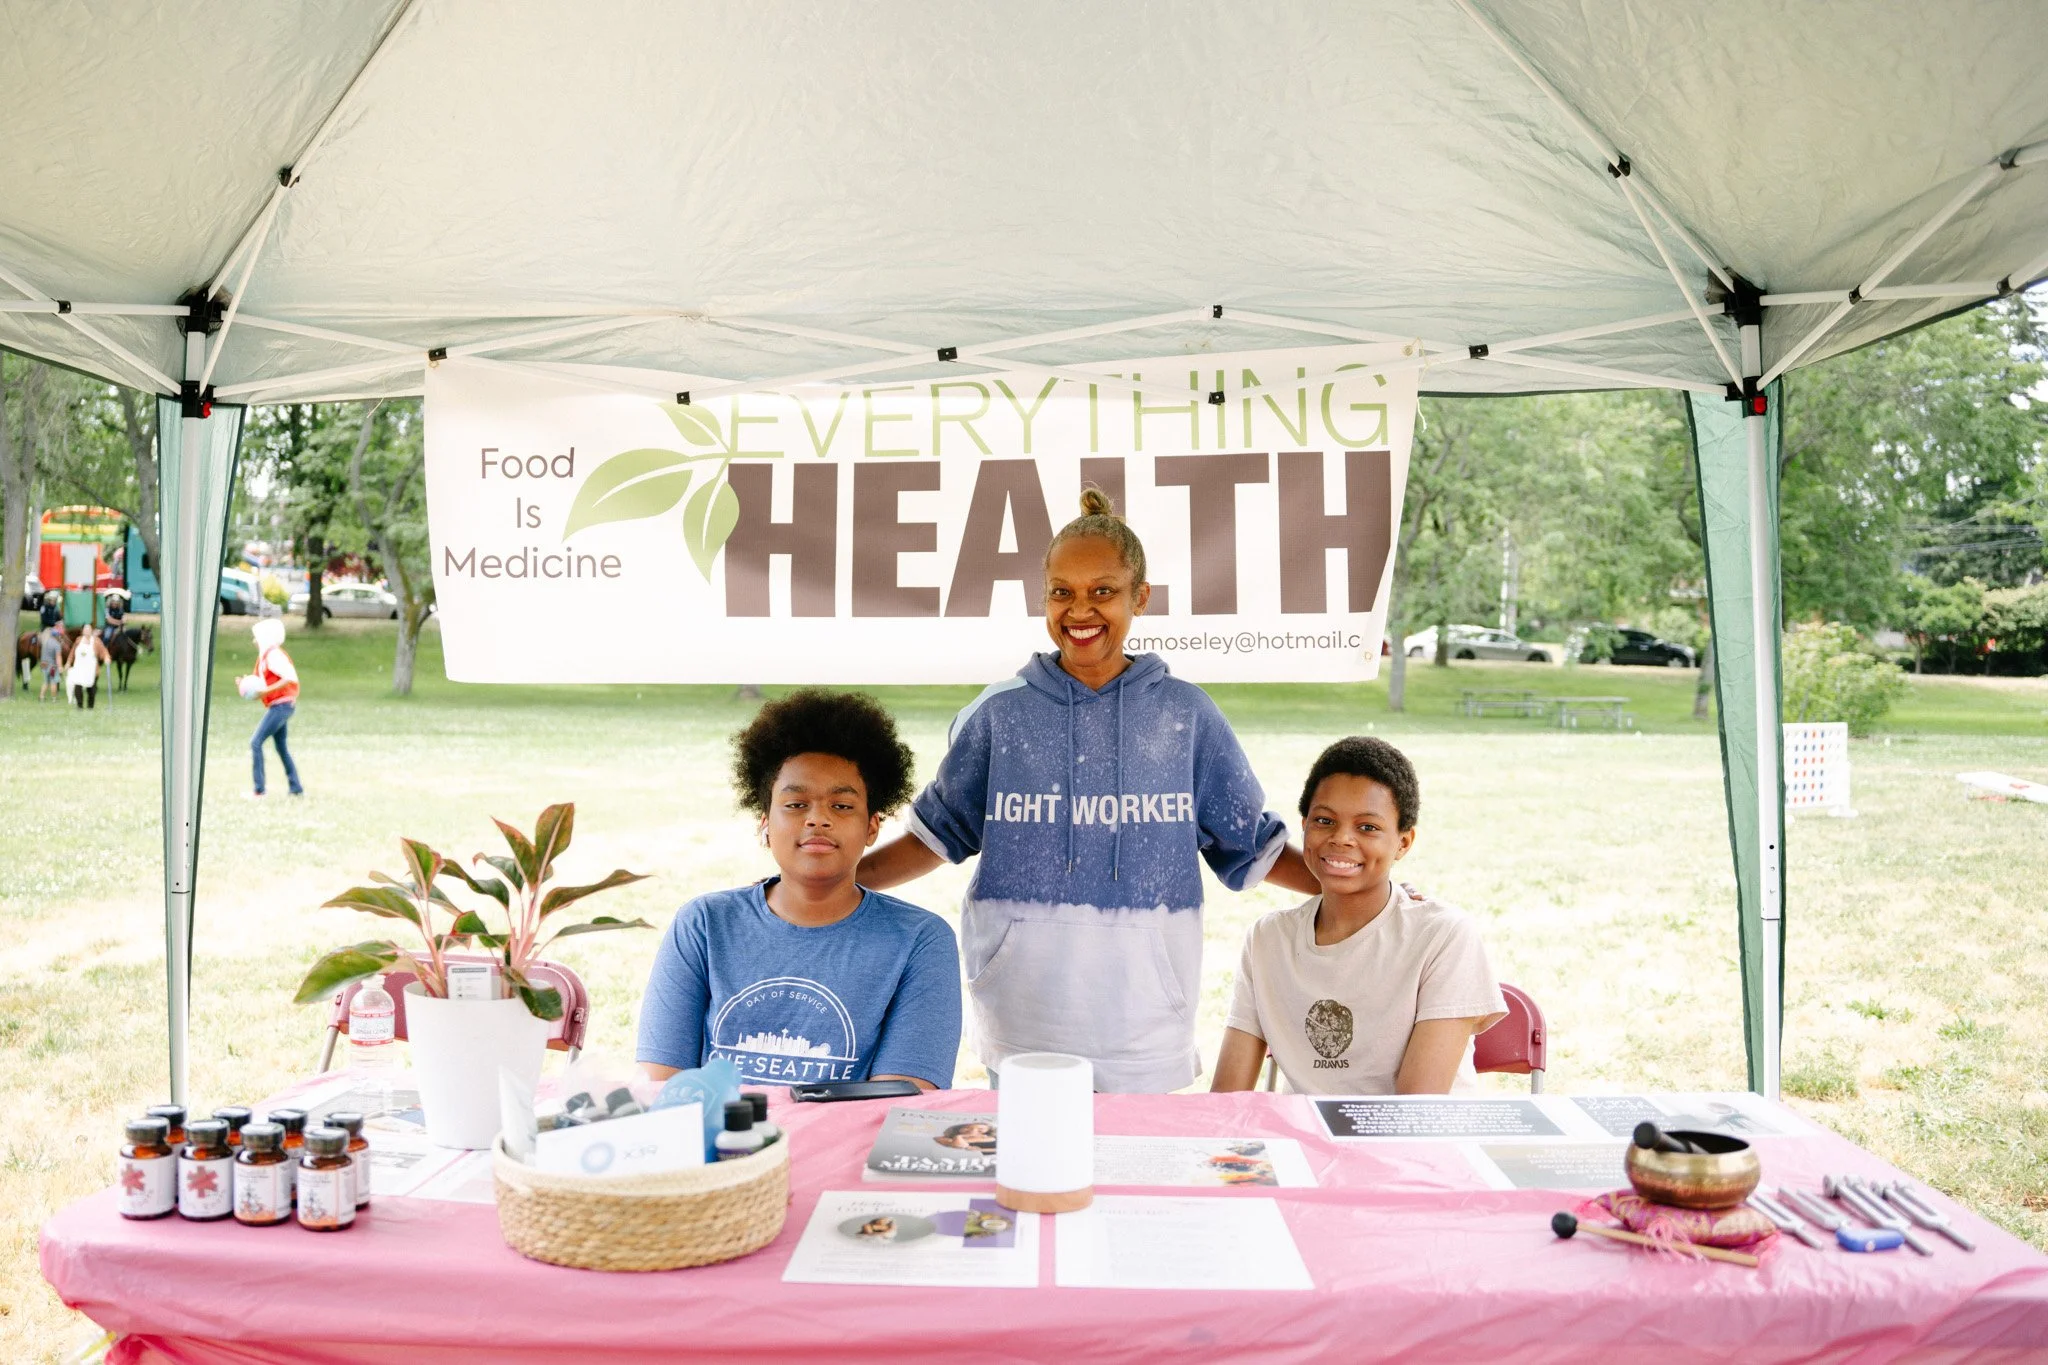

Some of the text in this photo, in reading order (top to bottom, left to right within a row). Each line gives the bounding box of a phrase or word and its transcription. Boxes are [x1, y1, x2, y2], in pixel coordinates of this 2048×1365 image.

[730, 363, 1389, 459] EVERYTHING
[481, 446, 575, 479] Food
[516, 497, 541, 529] Is
[725, 450, 1391, 617] HEATH
[445, 545, 622, 578] Medicine
[1123, 631, 1361, 654] amoseley@hotmail.c
[985, 792, 1194, 825] IGHT WORKER
[746, 990, 828, 1014] DAY OF SERVICE
